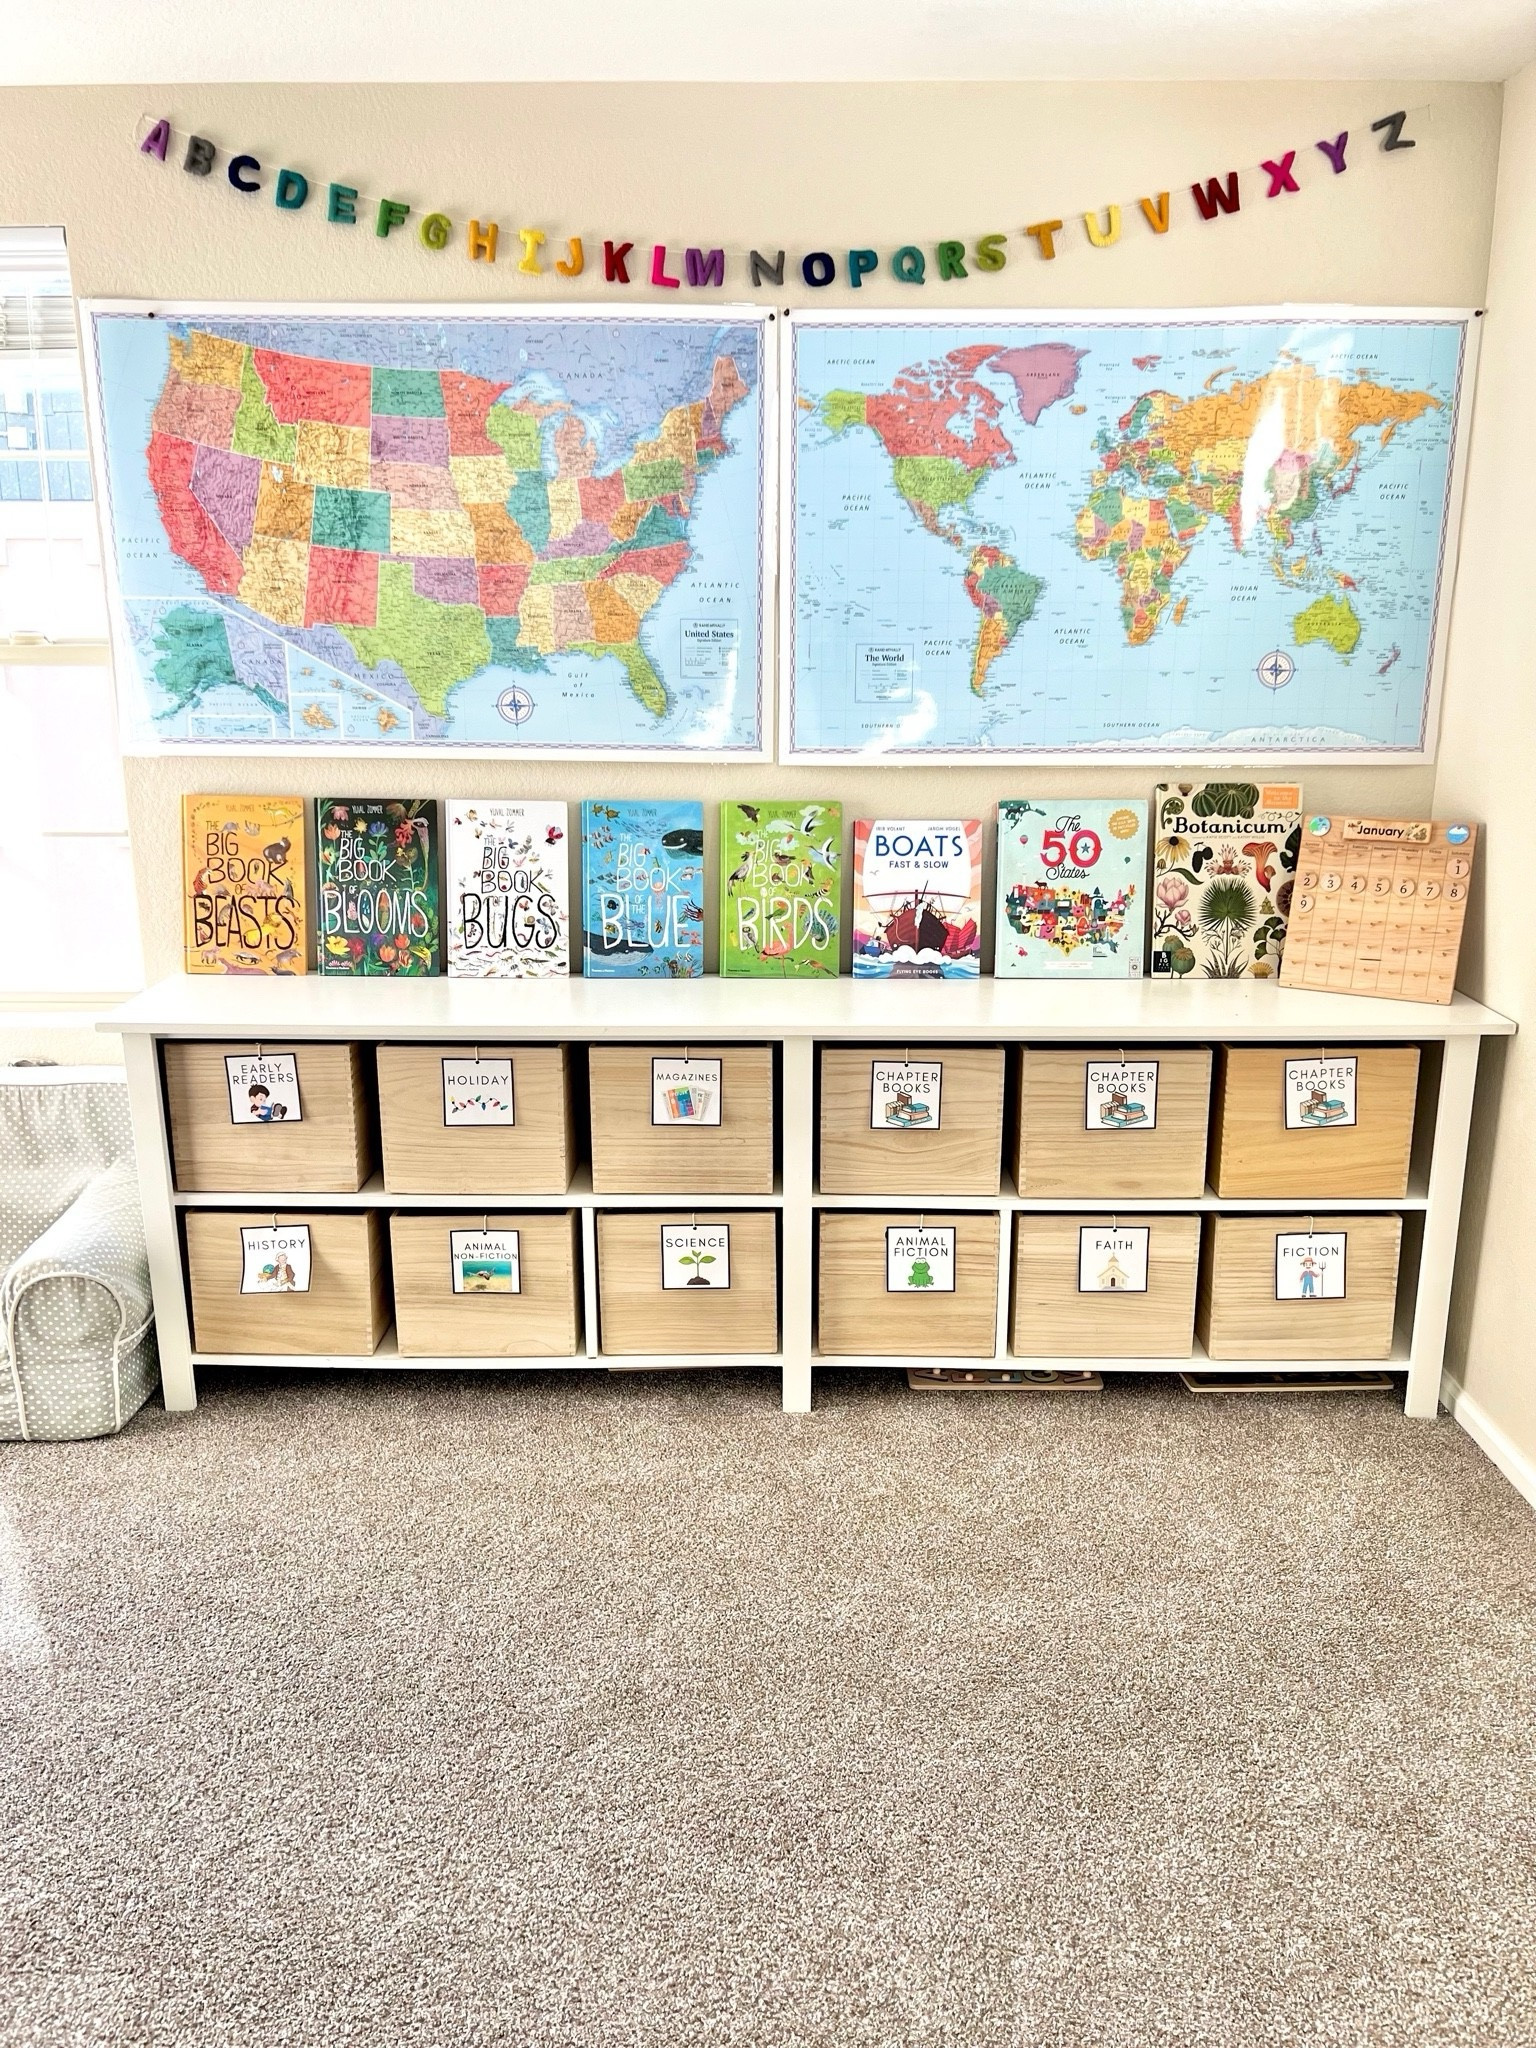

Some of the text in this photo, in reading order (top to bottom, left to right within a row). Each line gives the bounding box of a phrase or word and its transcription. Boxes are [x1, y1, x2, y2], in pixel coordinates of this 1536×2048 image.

[685, 630, 734, 638] United States
[865, 653, 905, 662] The World
[489, 808, 525, 817] YUVAL ZOMMER
[206, 820, 220, 831] THE
[1055, 815, 1081, 834] The
[1172, 816, 1287, 834] Botanicum
[341, 829, 353, 838] THE
[619, 832, 633, 843] THE
[756, 829, 769, 839] THE
[1357, 825, 1405, 839] January
[206, 832, 239, 856] BIG
[484, 836, 496, 847] THE
[875, 835, 963, 857] BOATS
[339, 837, 366, 861] BIG
[754, 839, 783, 864] BIG
[1040, 829, 1104, 868] 50
[482, 846, 510, 870] BIG
[617, 843, 647, 868] BIG
[338, 859, 397, 882] BOOK
[889, 861, 911, 869] FAST
[914, 861, 921, 869] &
[1455, 865, 1461, 875] 1
[206, 857, 285, 886] BOOK
[752, 863, 816, 888] BOOK
[1046, 862, 1090, 880] States
[480, 870, 545, 894] BOOK
[616, 867, 682, 893] BOOK
[235, 884, 247, 895] OF
[348, 884, 358, 894] OF
[767, 887, 776, 897] OF
[1303, 877, 1458, 898] 2 3 4 5 6 7 8
[634, 894, 643, 904] OF
[1300, 899, 1307, 909] 9
[323, 889, 430, 938] BLOOMS
[631, 904, 646, 915] THE
[193, 894, 297, 950] BEASTS
[462, 893, 557, 949] BUGS
[600, 893, 692, 950] BLUE
[737, 896, 834, 951] BIRDS
[241, 1063, 283, 1075] EARLY
[1288, 1067, 1354, 1080] CHAPTER
[233, 1072, 294, 1085] READERS
[447, 1075, 509, 1086] HOLIDAY
[656, 1073, 718, 1082] MAGAZINES
[876, 1071, 939, 1082] CHAPTER
[1090, 1071, 1154, 1082] CHAPTER
[883, 1083, 931, 1094] BOOKS
[1097, 1083, 1147, 1094] BOOKS
[1296, 1079, 1346, 1092] BOOKS
[247, 1238, 306, 1251] HISTORY
[464, 1242, 506, 1251] ANIMAL
[665, 1238, 725, 1248] SCIENCE
[896, 1236, 946, 1246] ANIMAL
[1095, 1240, 1133, 1250] FAITH
[893, 1247, 949, 1257] FICTION
[1282, 1246, 1339, 1257] FICTION
